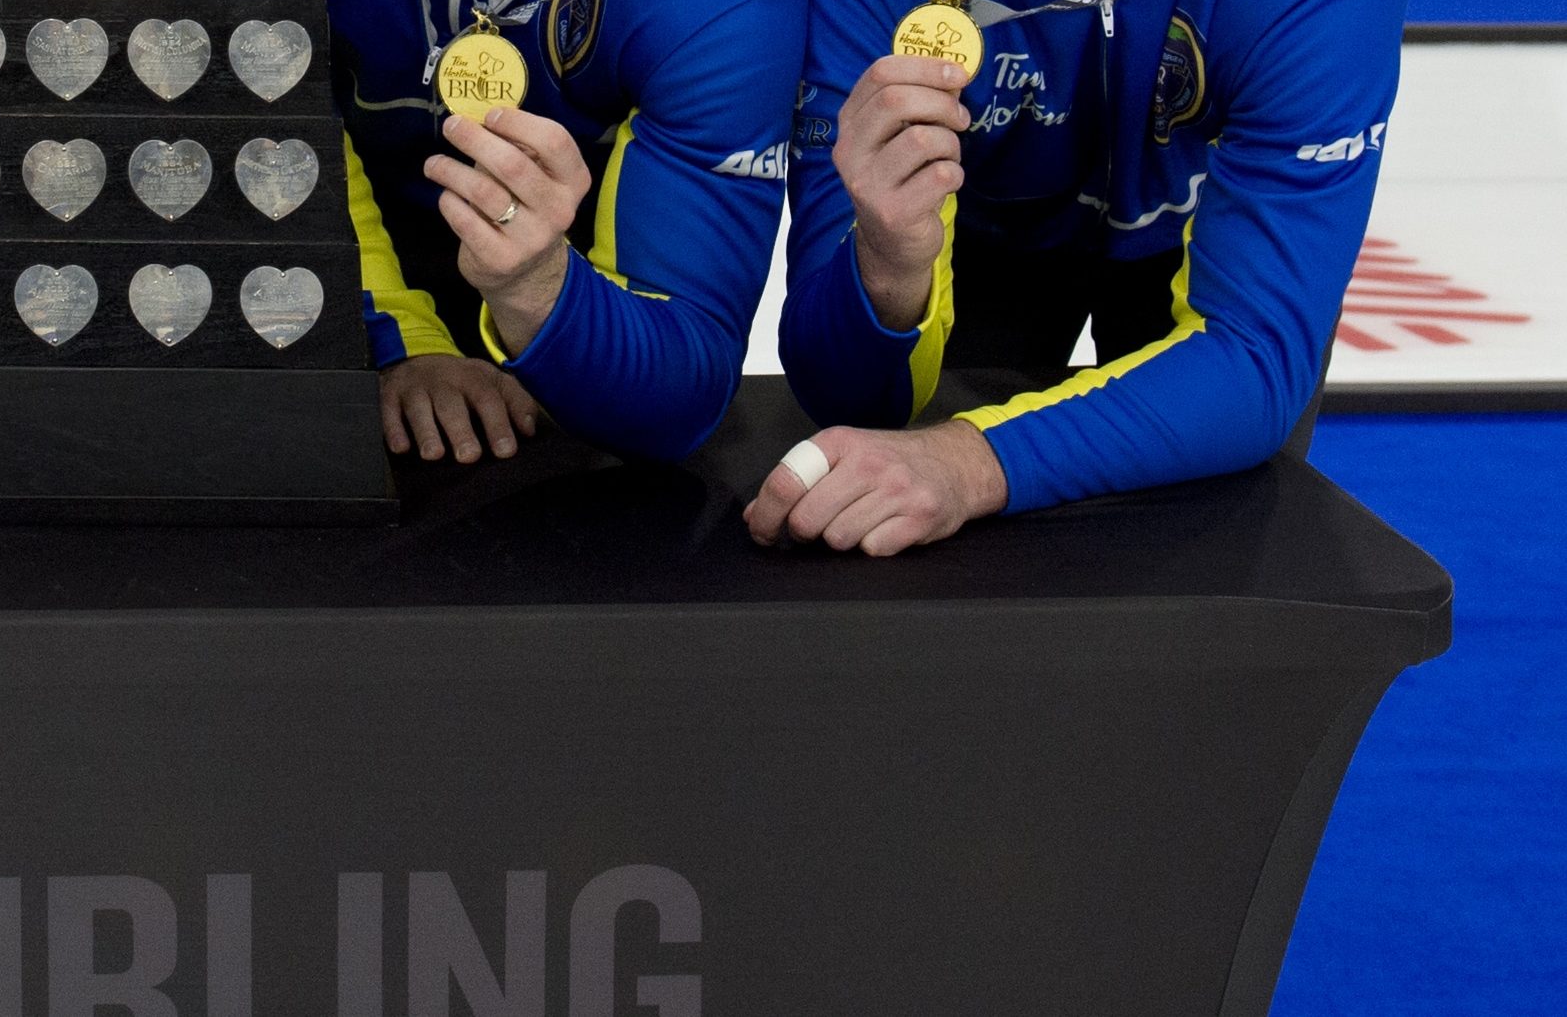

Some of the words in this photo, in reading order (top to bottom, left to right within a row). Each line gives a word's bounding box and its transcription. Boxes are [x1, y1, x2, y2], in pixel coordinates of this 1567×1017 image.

[910, 22, 926, 35] Tim
[898, 32, 935, 48] Hortons
[451, 55, 469, 68] Tim
[443, 67, 478, 79] Hortons
[994, 51, 1046, 91] Tim
[448, 77, 518, 104] BRIER
